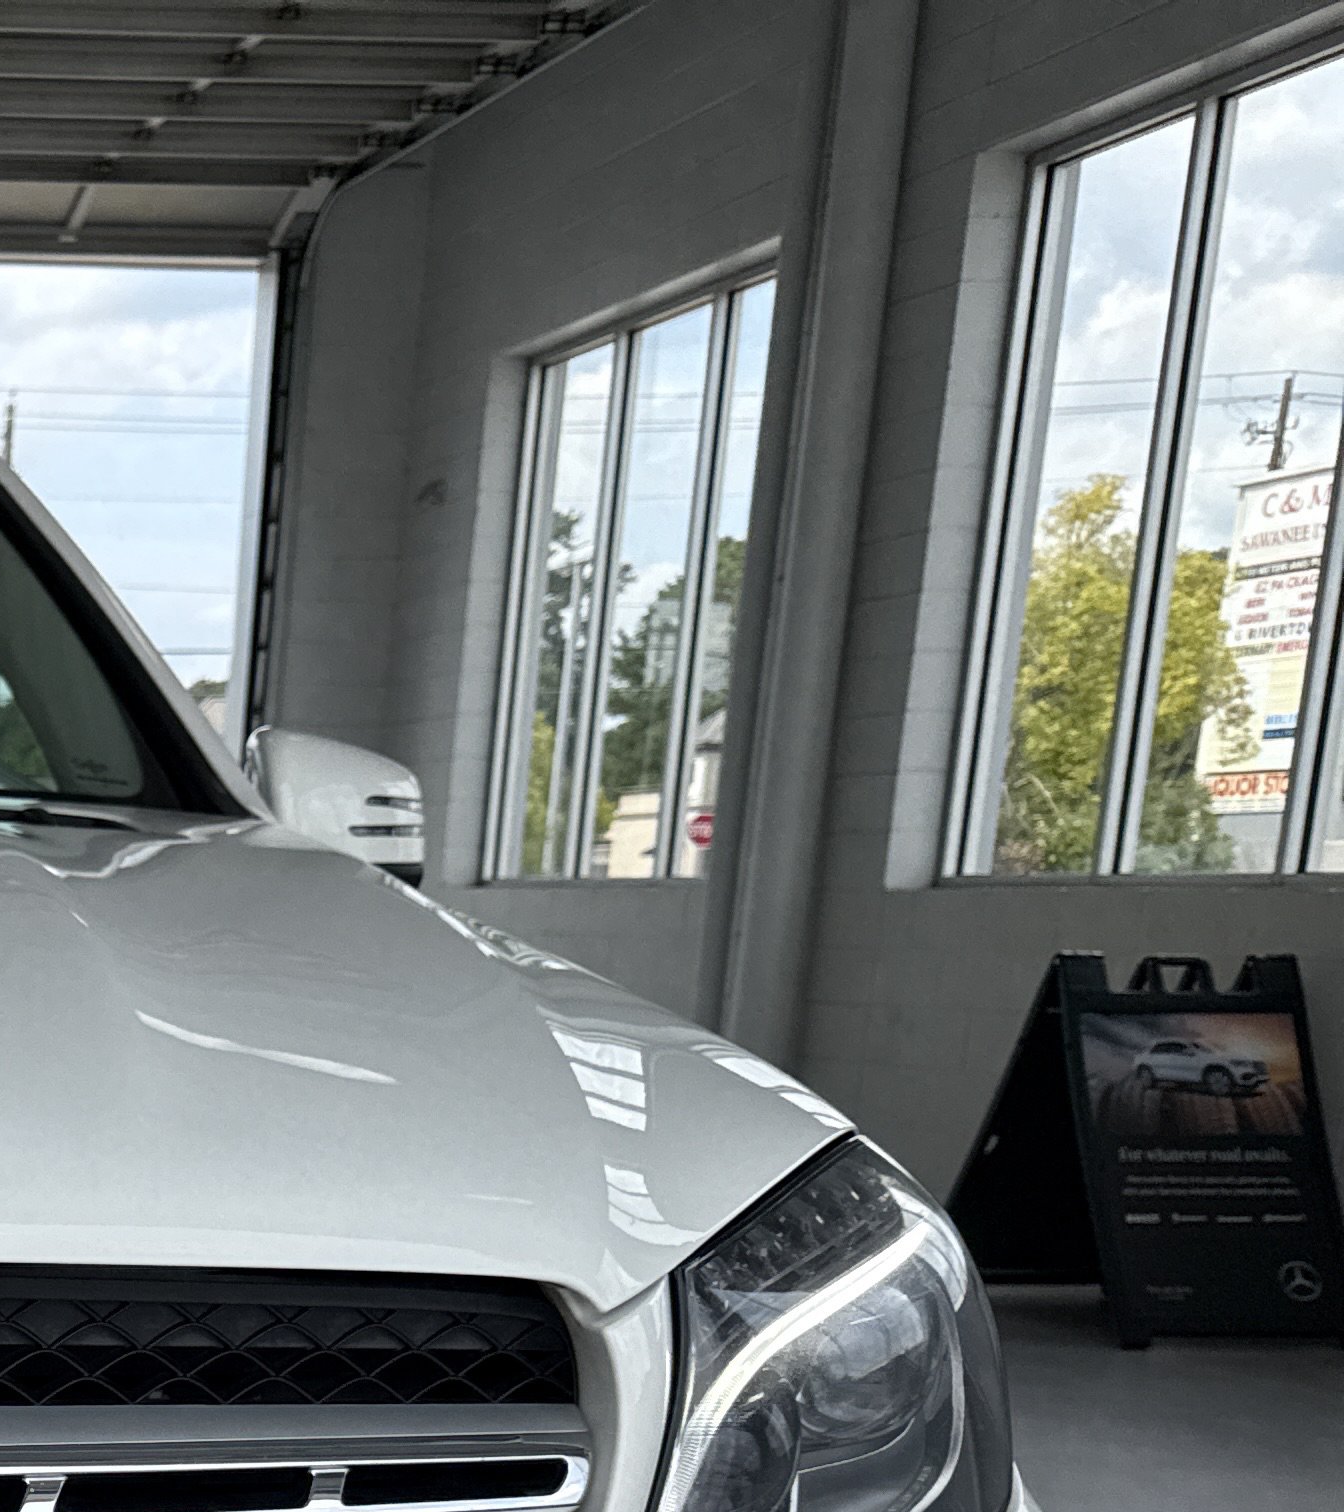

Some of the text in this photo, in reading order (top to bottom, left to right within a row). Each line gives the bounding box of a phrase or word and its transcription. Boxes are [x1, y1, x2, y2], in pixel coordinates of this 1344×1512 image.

[1262, 493, 1279, 518] C
[1279, 488, 1304, 515] &
[1248, 622, 1312, 641] RIVERTO
